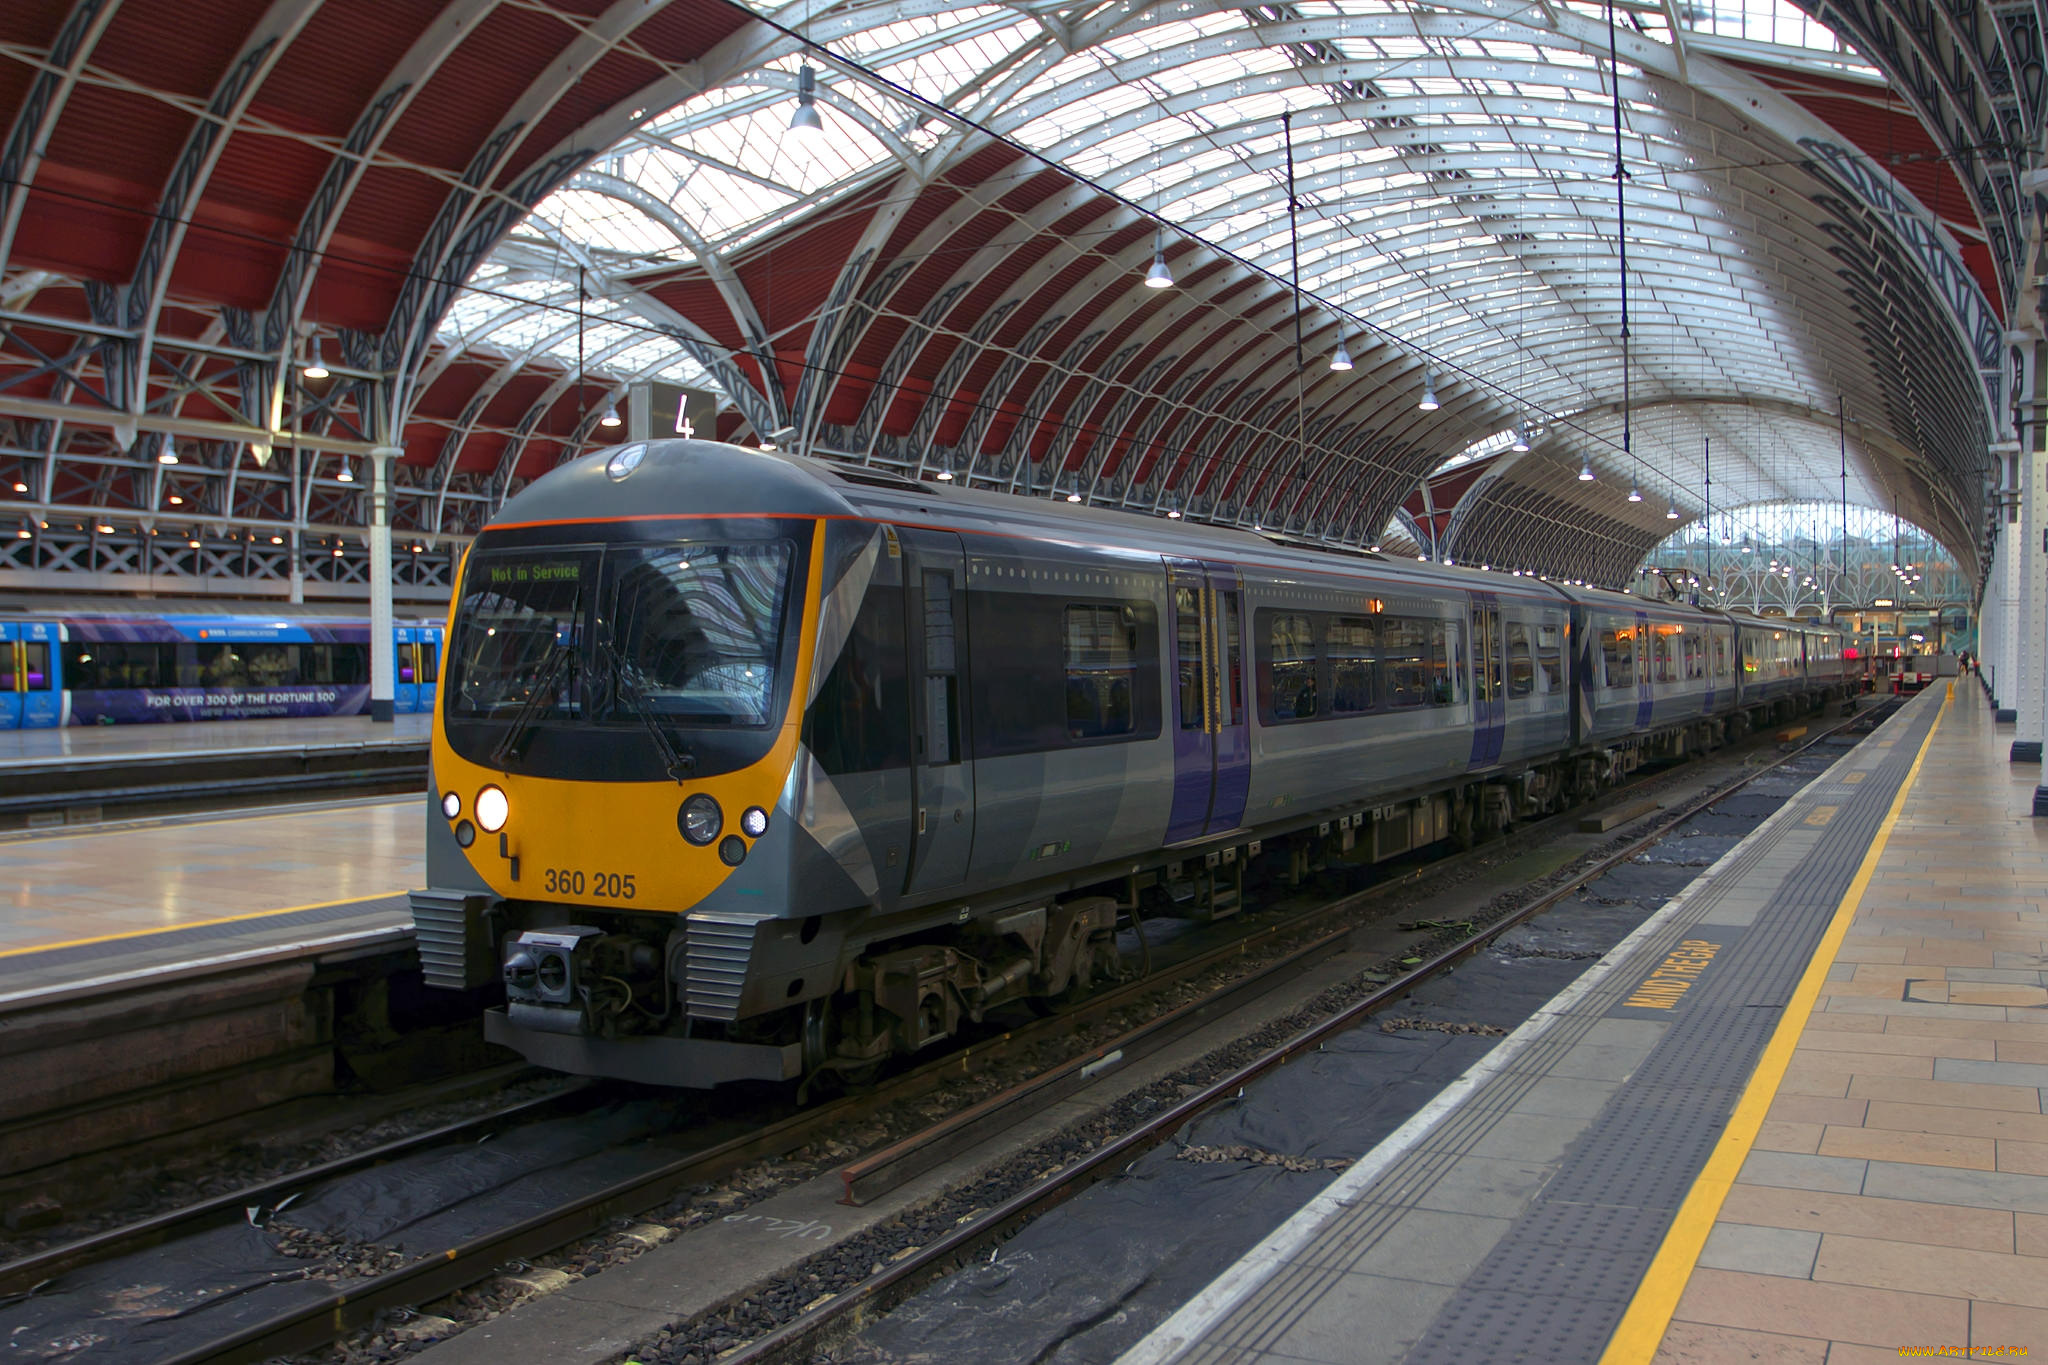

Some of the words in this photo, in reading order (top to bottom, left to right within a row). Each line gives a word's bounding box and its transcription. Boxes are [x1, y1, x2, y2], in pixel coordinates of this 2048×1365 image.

[675, 393, 695, 440] 4
[491, 567, 512, 581] Not
[517, 567, 528, 581] in
[532, 565, 579, 580] Service
[147, 694, 171, 707] FOR
[173, 694, 204, 707] OVER
[207, 693, 228, 706] 300
[230, 693, 245, 705] OF
[248, 692, 266, 704] THE
[269, 692, 315, 704] FORTUNE
[317, 691, 336, 703] 500
[545, 868, 585, 895] 360
[593, 872, 636, 899] 205
[1668, 939, 1722, 959] GAP
[1650, 958, 1710, 978] THE
[1622, 979, 1692, 1009] MIND
